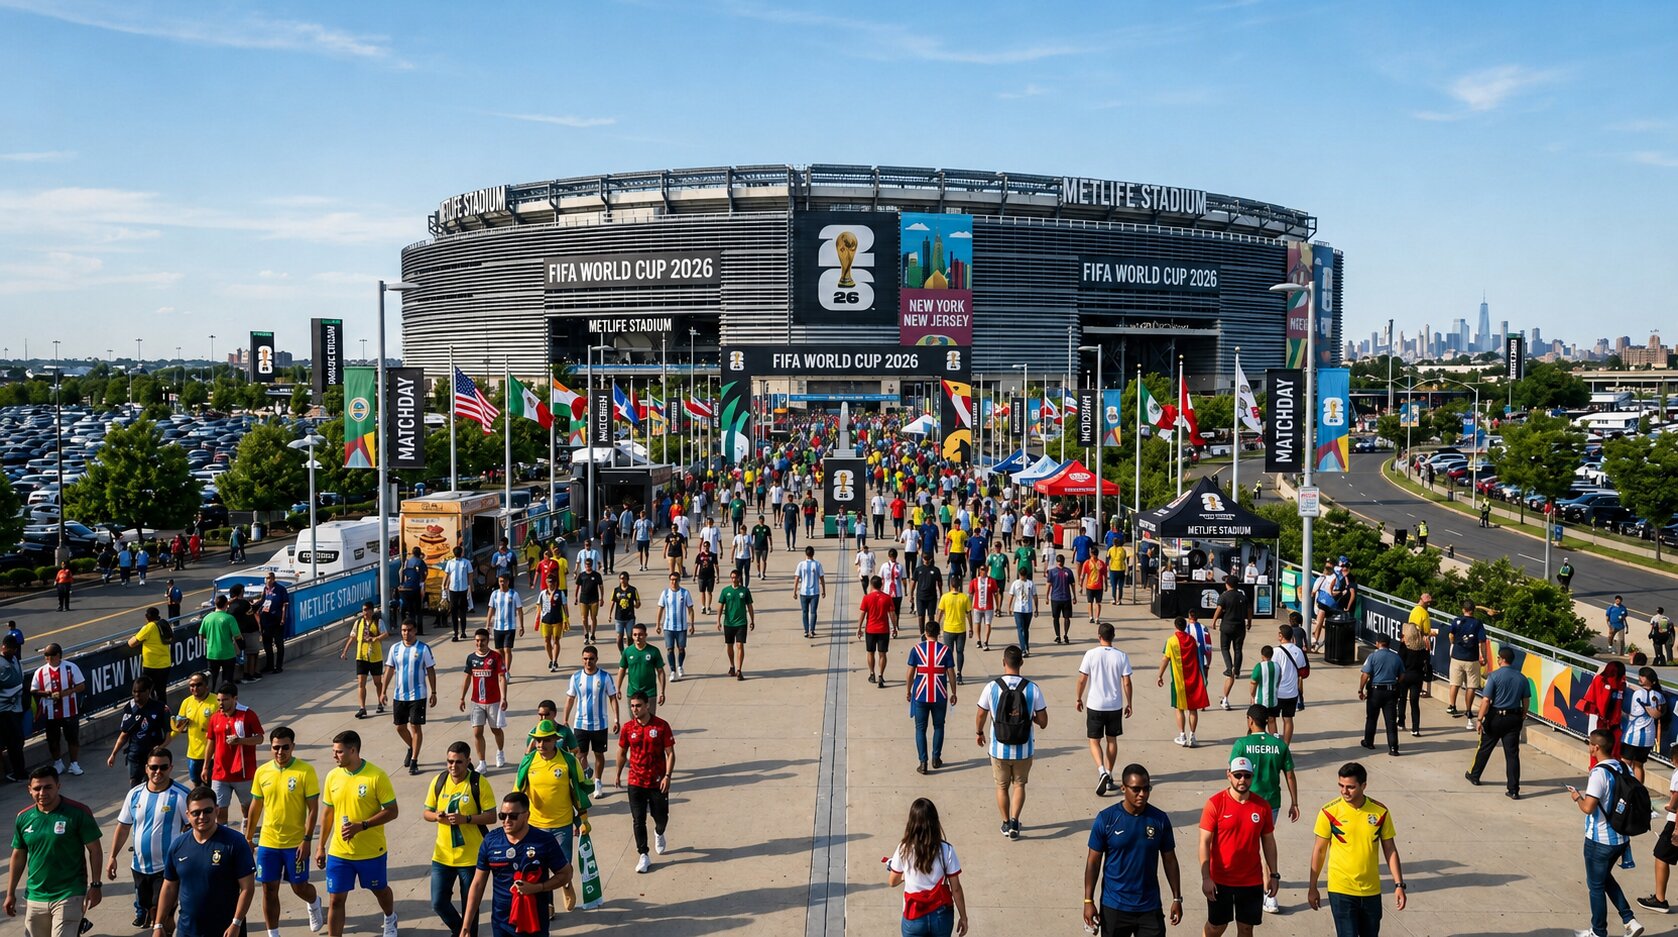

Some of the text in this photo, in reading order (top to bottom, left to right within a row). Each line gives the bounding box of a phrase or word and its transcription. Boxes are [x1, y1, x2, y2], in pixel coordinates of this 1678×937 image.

[463, 185, 506, 217] STADIUM
[1063, 177, 1207, 215] METLIFE STADIUM
[549, 257, 714, 284] FIFA WORLD CUP 2026
[1083, 262, 1217, 288] FIFA WORLD CUP 2026
[833, 291, 860, 304] 26
[909, 299, 965, 313] NEW YORK
[589, 318, 672, 333] METLIFE STADIUM
[903, 314, 969, 327] NEW JERSEY
[773, 353, 919, 369] FIFA WORLD CUP 2026
[397, 376, 416, 461] MATCHDAY
[1275, 378, 1294, 463] MATCHDAY
[1188, 525, 1251, 535] METLIFE STADIUM
[300, 579, 372, 622] METLIFE STADIUM
[1366, 609, 1401, 642] METLIFE
[91, 659, 126, 696] NEW
[1246, 744, 1280, 755] NIGERIA
